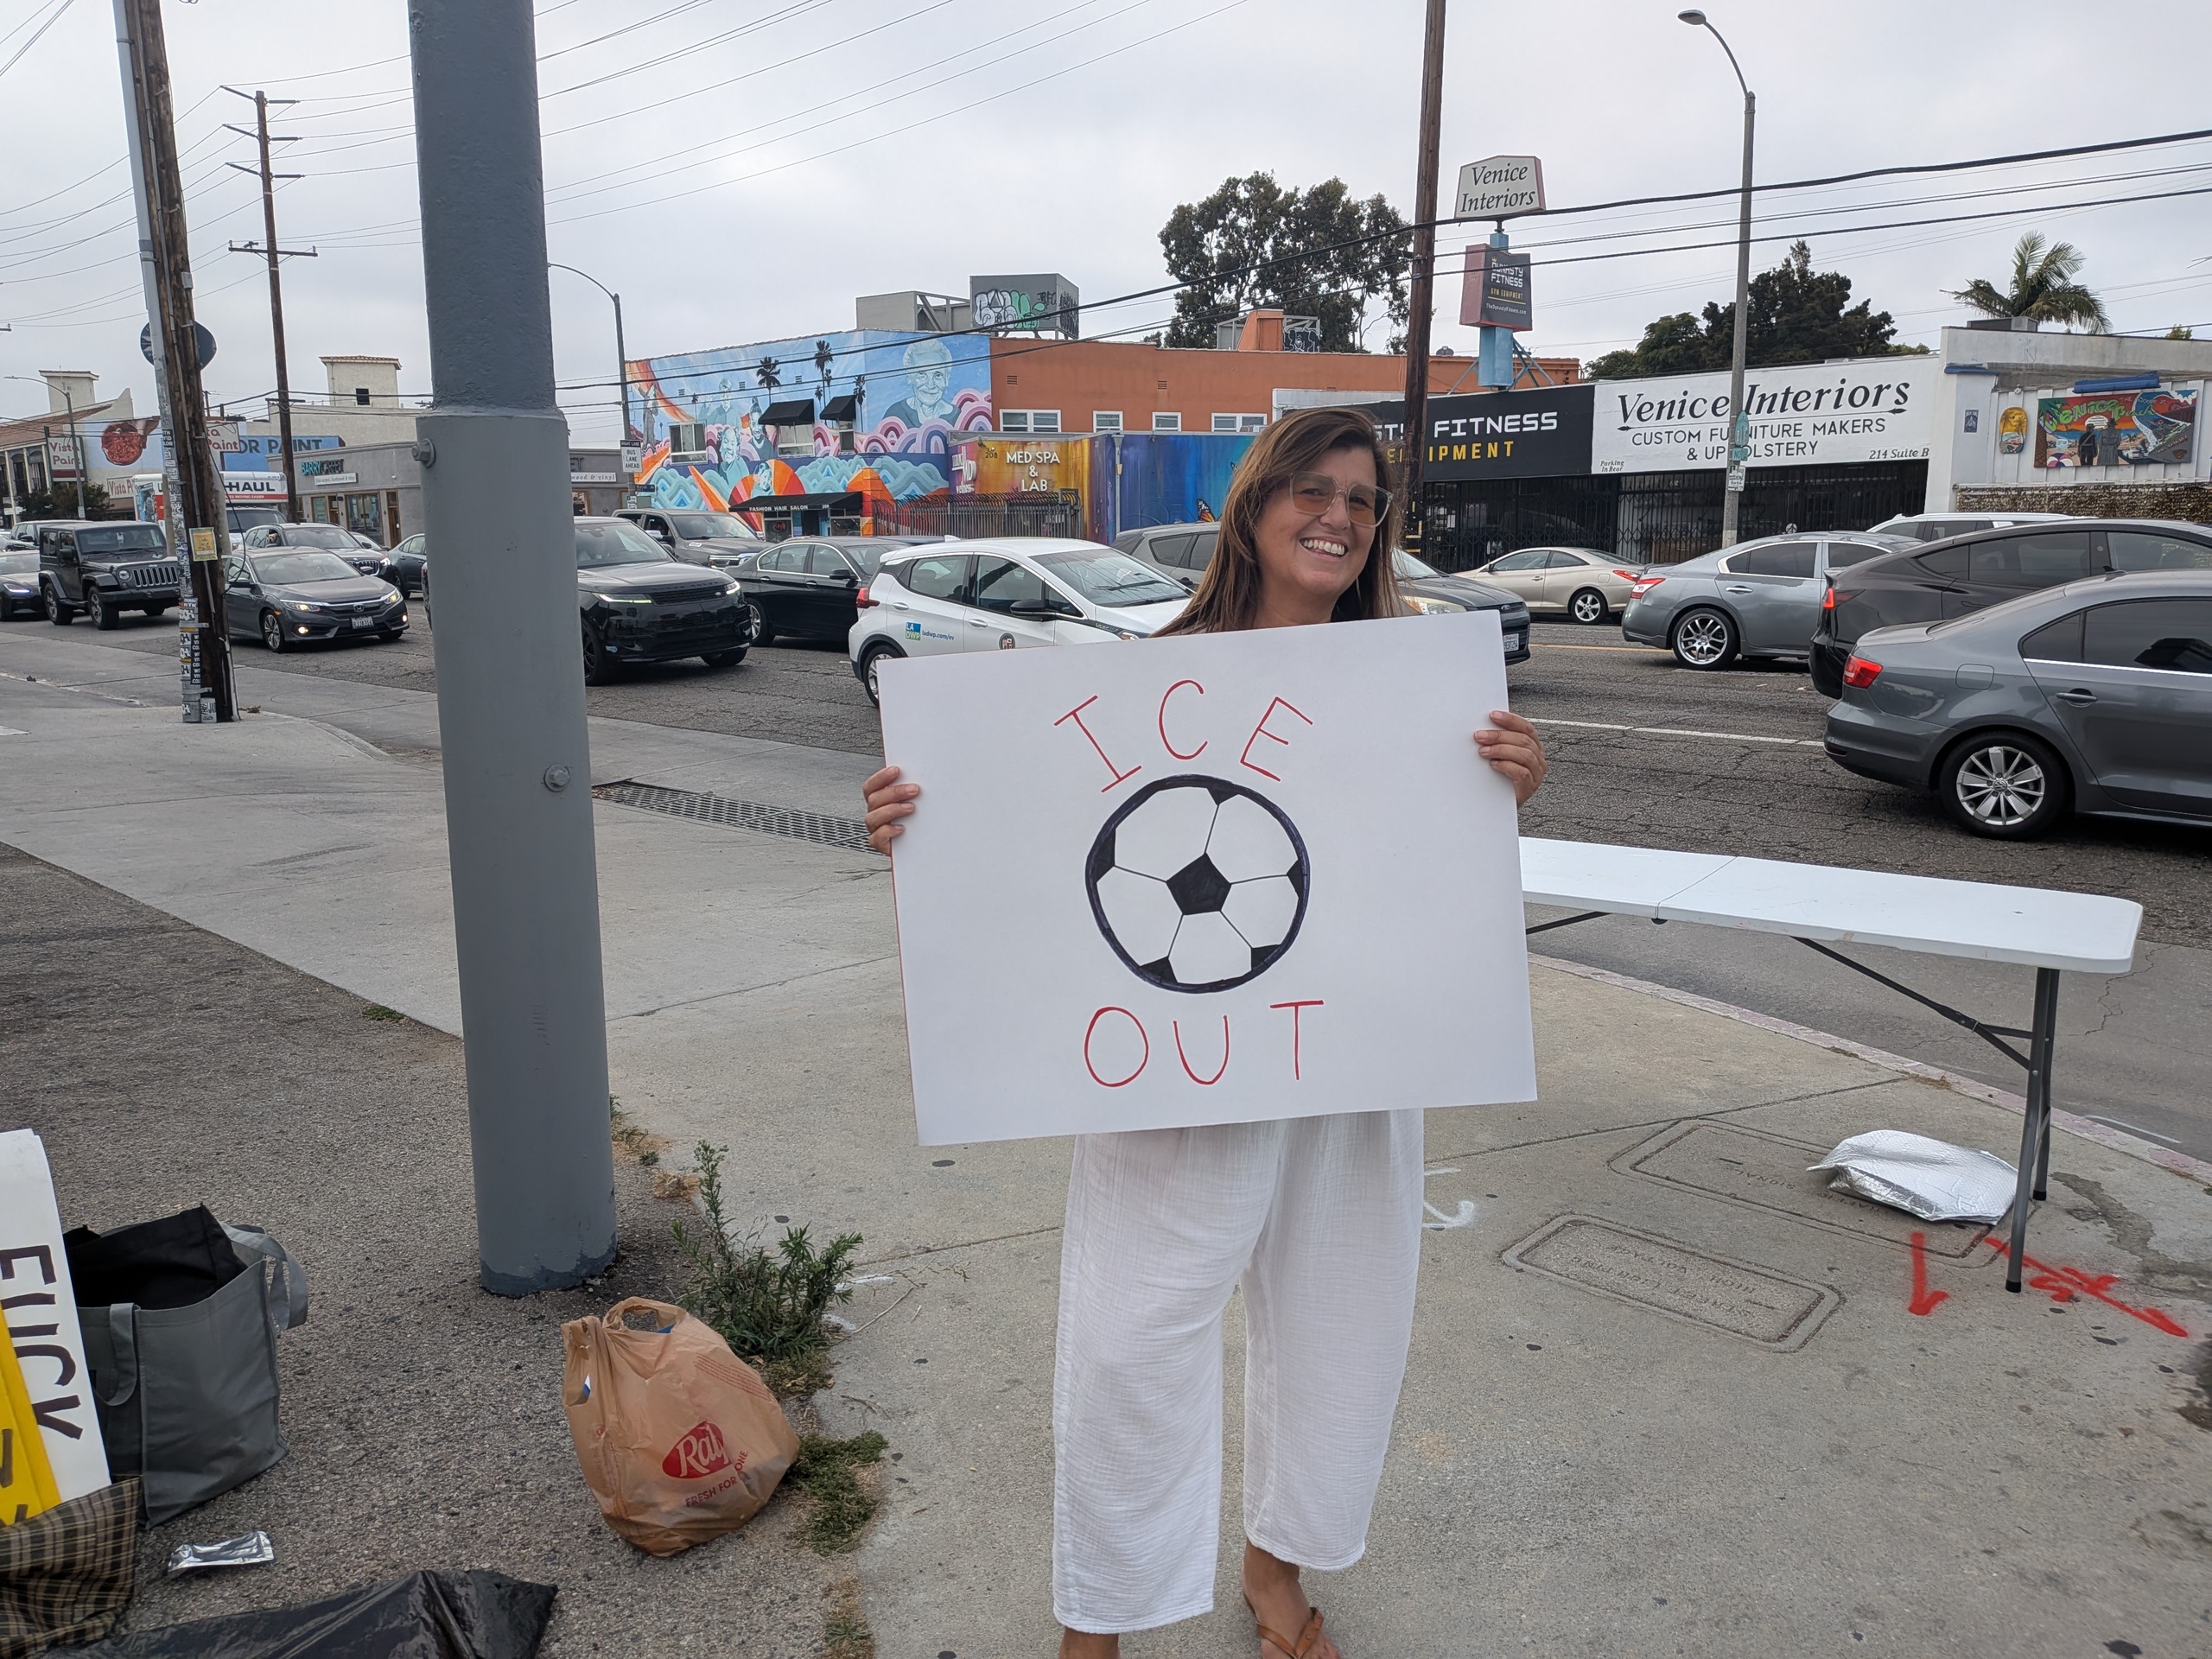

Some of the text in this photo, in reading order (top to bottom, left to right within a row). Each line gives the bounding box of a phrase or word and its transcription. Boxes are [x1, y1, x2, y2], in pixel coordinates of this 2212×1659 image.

[1471, 162, 1528, 186] Venice
[1460, 188, 1535, 213] Interiors
[1491, 273, 1523, 288] FITNESS
[1618, 378, 1910, 423] Venice Interiors
[1434, 411, 1558, 438] FITNESS
[1632, 430, 1700, 446] CUSTOM
[1710, 423, 1802, 442] FUNITURE
[1813, 418, 1885, 436] MAKERS
[268, 439, 322, 454] PINT
[1387, 441, 1514, 464] EIPMENT
[1687, 441, 1818, 461] & UPOLSTERY
[1869, 448, 1929, 460] 214 Suite B
[1006, 451, 1061, 464] MED SPA
[300, 461, 321, 476] BARRY
[1028, 465, 1039, 477] &
[108, 480, 126, 496] Vista
[1020, 479, 1048, 492] LAB
[906, 622, 955, 640] LA ladwp.com/ev
[906, 631, 920, 640] DWP
[1054, 680, 1313, 793] ICE
[1084, 999, 1325, 1088] OUT
[0, 1244, 84, 1440] FUCK
[685, 1486, 716, 1508] FRESH
[718, 1476, 737, 1493] FOR
